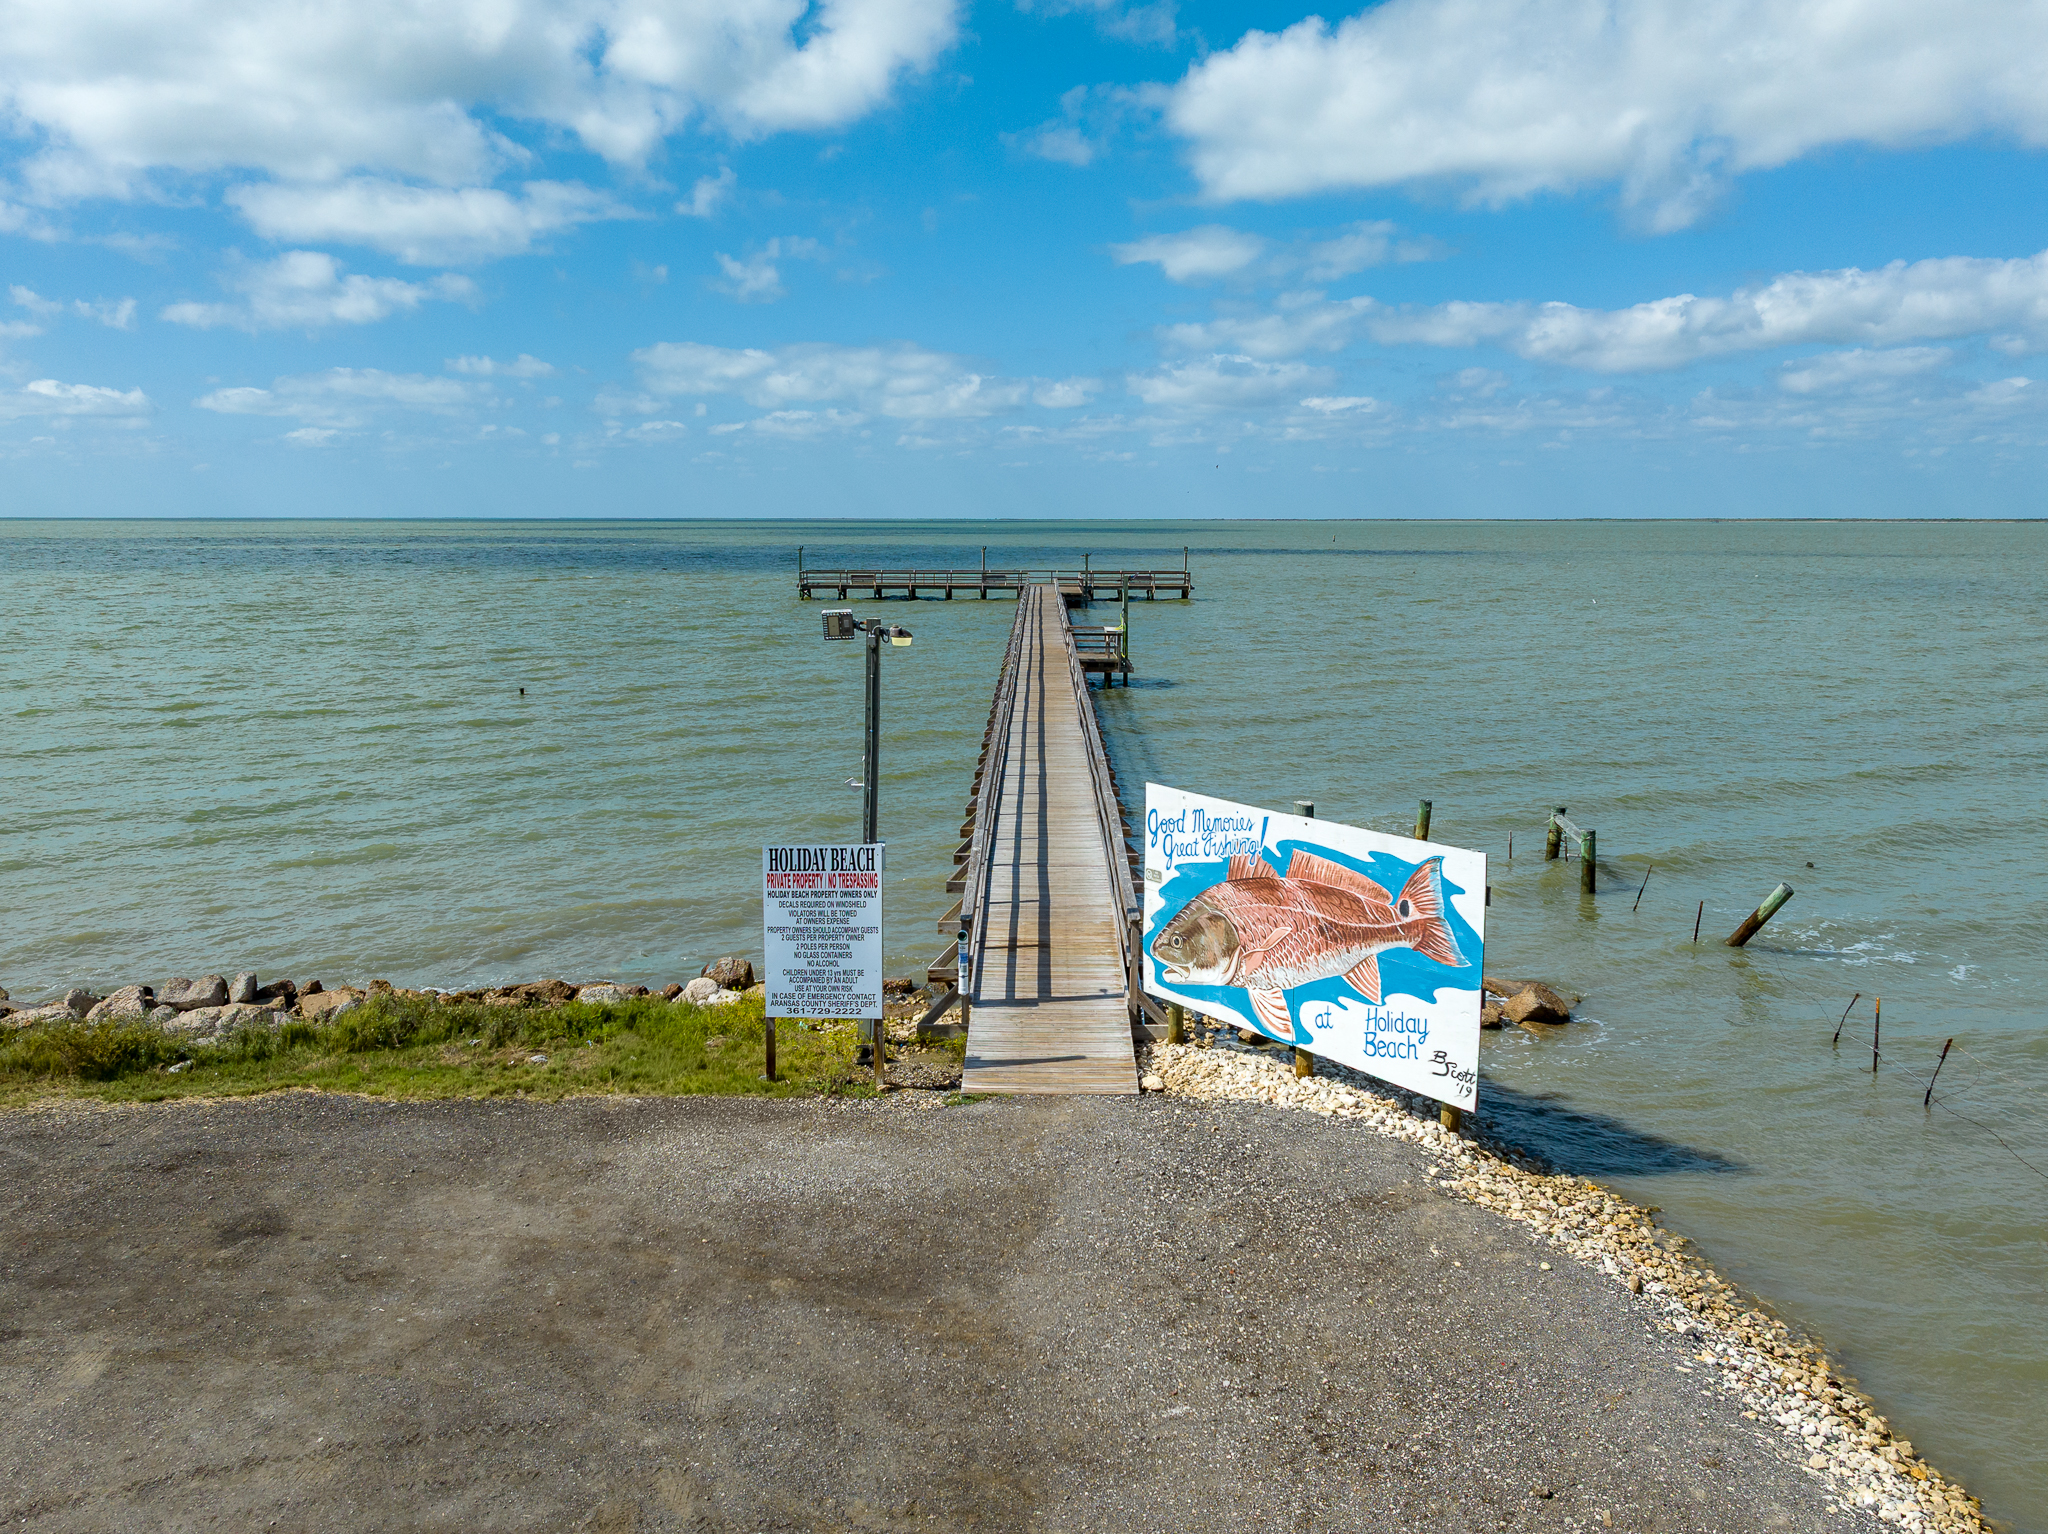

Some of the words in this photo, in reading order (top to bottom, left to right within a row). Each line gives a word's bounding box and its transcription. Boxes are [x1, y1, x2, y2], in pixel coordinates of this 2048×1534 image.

[1148, 808, 1186, 848] Good
[1192, 809, 1255, 833] Memories
[769, 848, 827, 872] HOLIDAY
[831, 848, 875, 872] BEACH
[1163, 834, 1200, 870] Great
[767, 873, 791, 889] PRIVATE
[793, 873, 823, 889] PROPERTY
[828, 873, 836, 889] NO
[838, 873, 878, 889] TRESPASSING
[1315, 1005, 1334, 1029] at
[1365, 1008, 1430, 1044] Holiday
[1363, 1032, 1418, 1059] Beach
[1432, 1062, 1476, 1084] Scott
